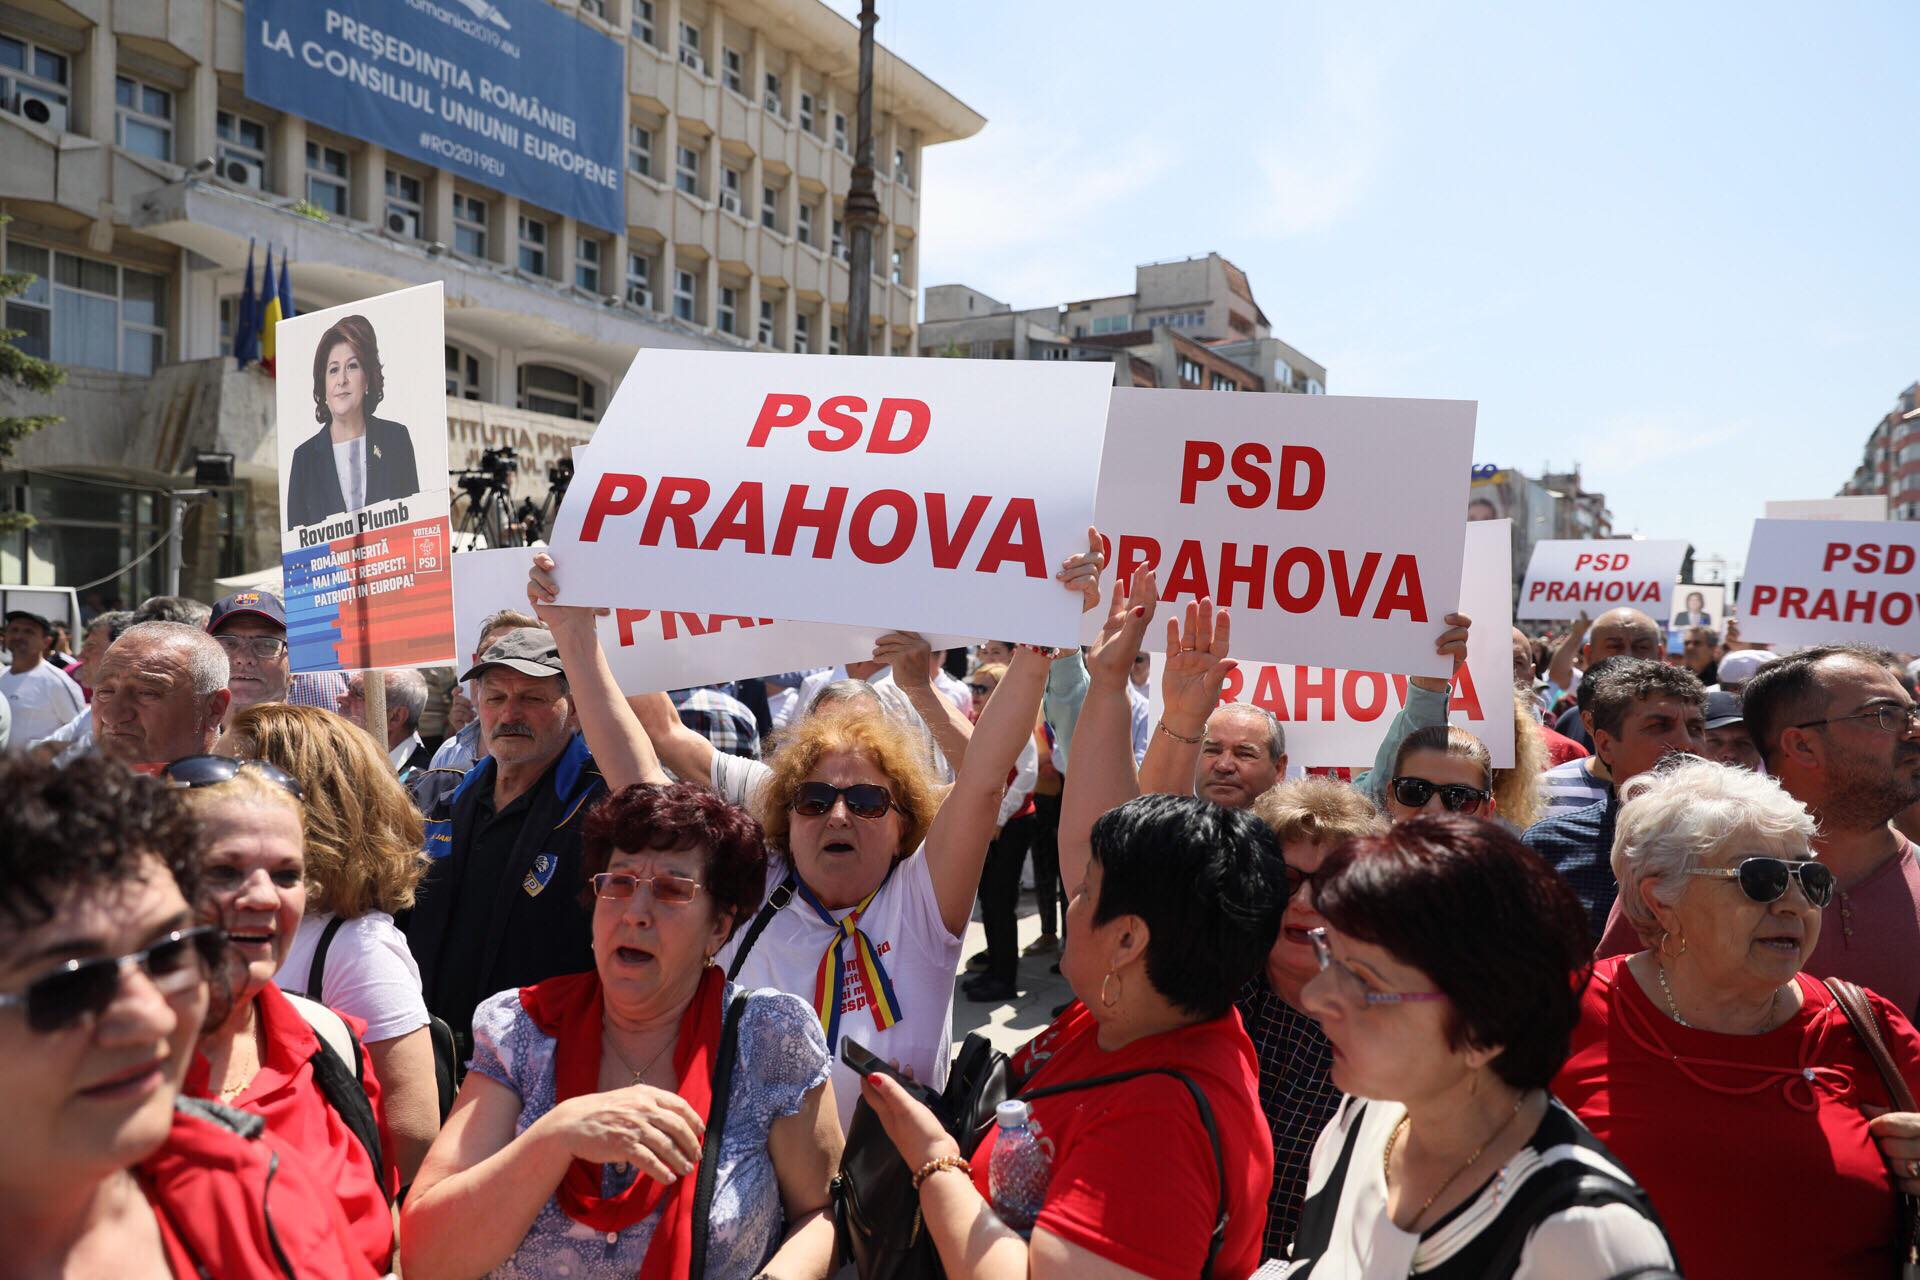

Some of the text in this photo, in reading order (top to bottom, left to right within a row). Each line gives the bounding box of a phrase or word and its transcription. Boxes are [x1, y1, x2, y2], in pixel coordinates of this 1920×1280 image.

[405, 0, 521, 59] omania2019.eu
[325, 9, 576, 141] PREȘEDINȚIA ROMÂNIEI
[262, 20, 618, 190] LA CONSILIUL UNIUNII EUROPENE
[419, 133, 505, 178] #RO2019EU
[746, 393, 932, 455] PSD
[1179, 440, 1326, 511] PSD
[299, 501, 409, 548] Rovana Plumb
[579, 472, 1048, 579] PRAHOVA
[310, 538, 389, 572] ROMÂNII MERITĂ
[312, 556, 407, 590] MAI MULT RESPECT!
[418, 556, 437, 569] PSD
[1574, 553, 1631, 571] PSD
[1822, 542, 1915, 575] PSD
[314, 589, 356, 608] PATRIOȚI
[370, 574, 415, 595] EUROPA!
[1529, 581, 1661, 601] PRAHOVA
[1750, 585, 1920, 626] PRAHO
